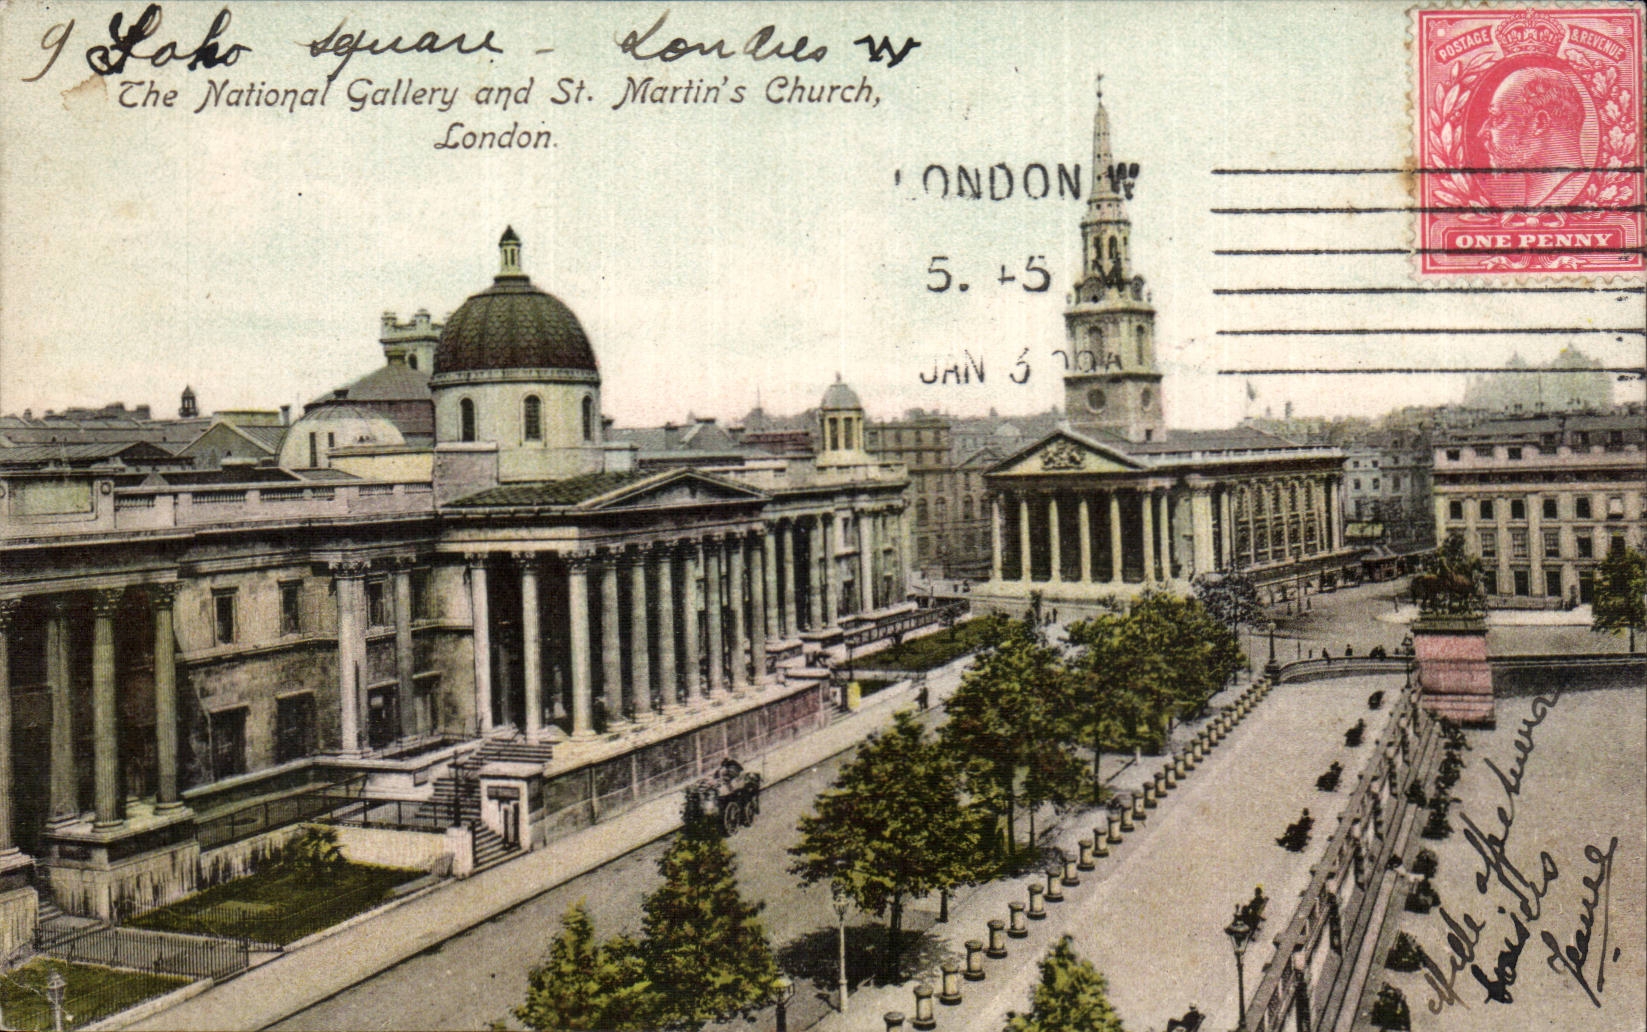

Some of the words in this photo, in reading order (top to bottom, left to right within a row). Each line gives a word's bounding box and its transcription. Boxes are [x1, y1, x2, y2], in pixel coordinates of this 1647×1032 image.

[1438, 29, 1490, 60] POSTAGE
[894, 162, 1081, 201] ONDON
[1455, 234, 1513, 249] ONE
[1518, 233, 1614, 249] PENNY
